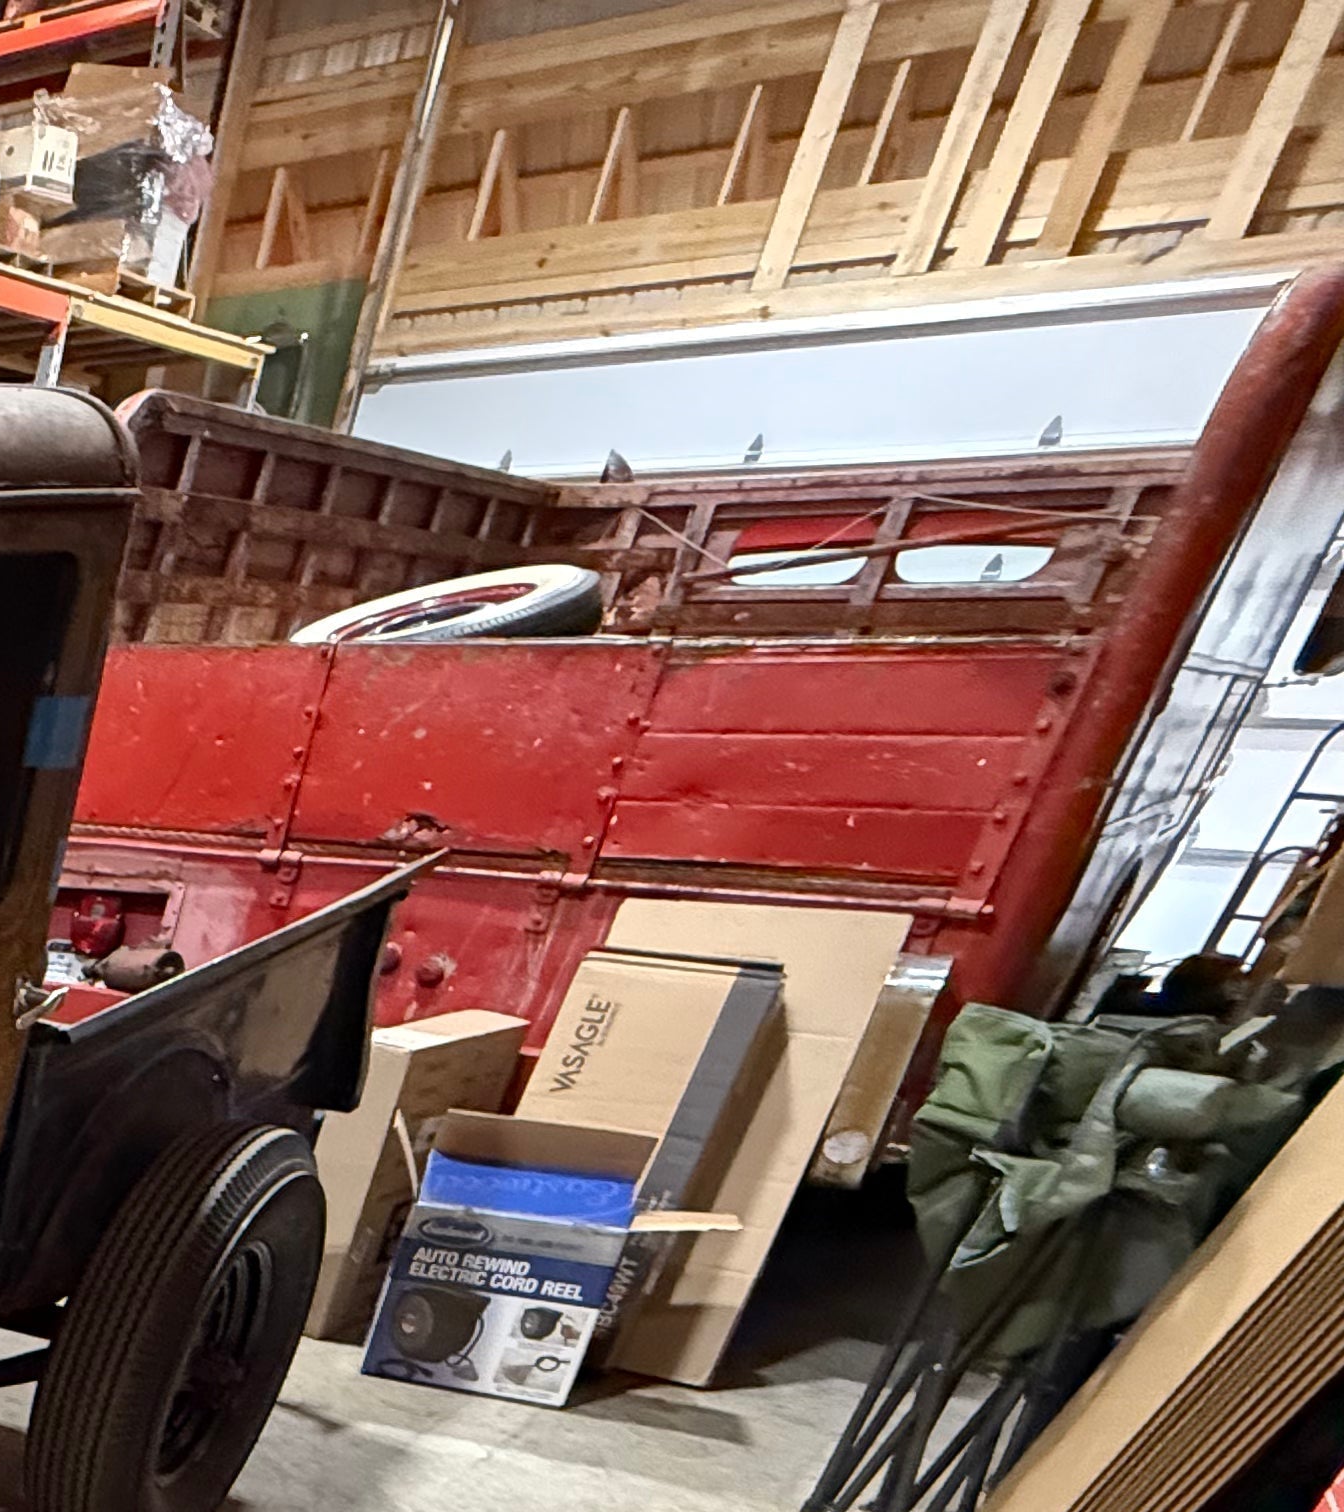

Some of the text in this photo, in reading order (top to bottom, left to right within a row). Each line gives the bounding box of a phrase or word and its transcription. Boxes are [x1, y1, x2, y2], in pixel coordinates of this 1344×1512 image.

[548, 998, 612, 1092] VASAGLE
[408, 1261, 584, 1302] ELECTRIC CORD REEL
[412, 1247, 531, 1277] AUTO REWIND
